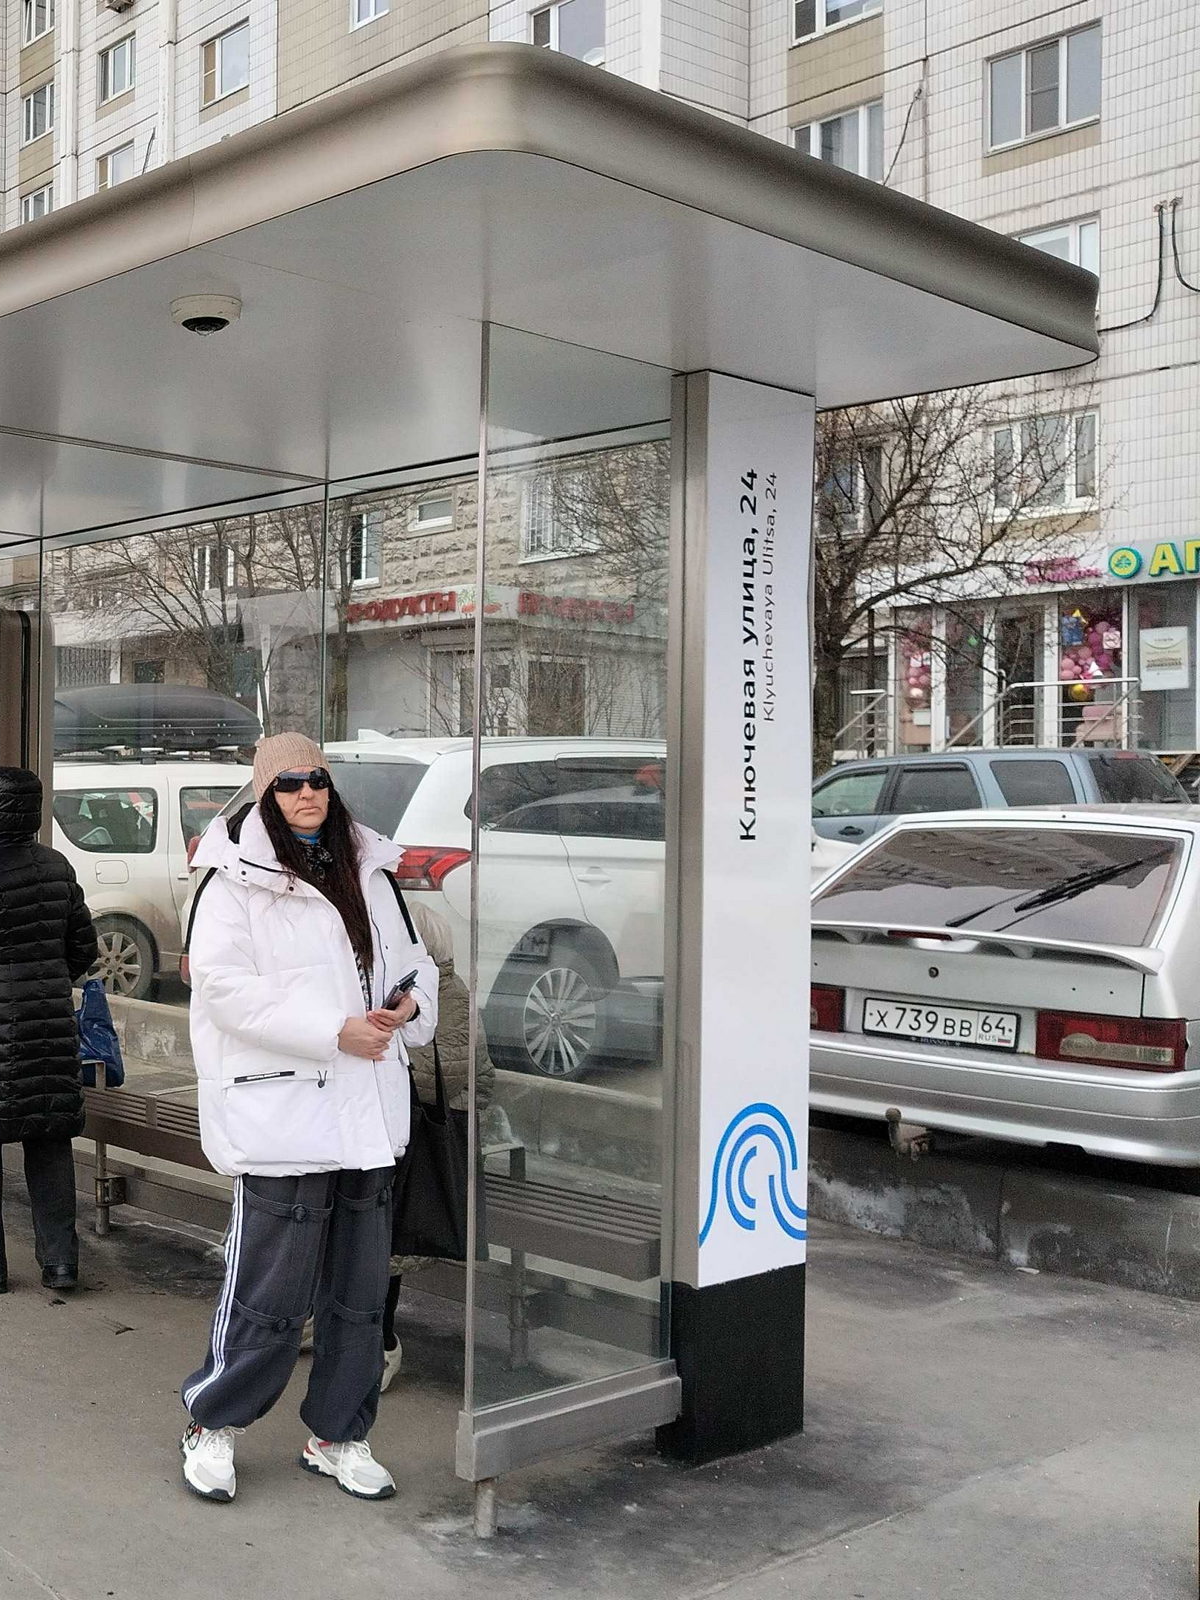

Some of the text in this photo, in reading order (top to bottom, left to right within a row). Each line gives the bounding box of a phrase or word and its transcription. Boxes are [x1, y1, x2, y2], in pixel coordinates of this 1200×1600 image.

[739, 469, 759, 841] Ключевая улица, 24
[763, 471, 778, 722] Klyuchevaya Ulitsa, 24
[978, 1033, 997, 1043] RUS
[981, 1014, 1006, 1036] 64
